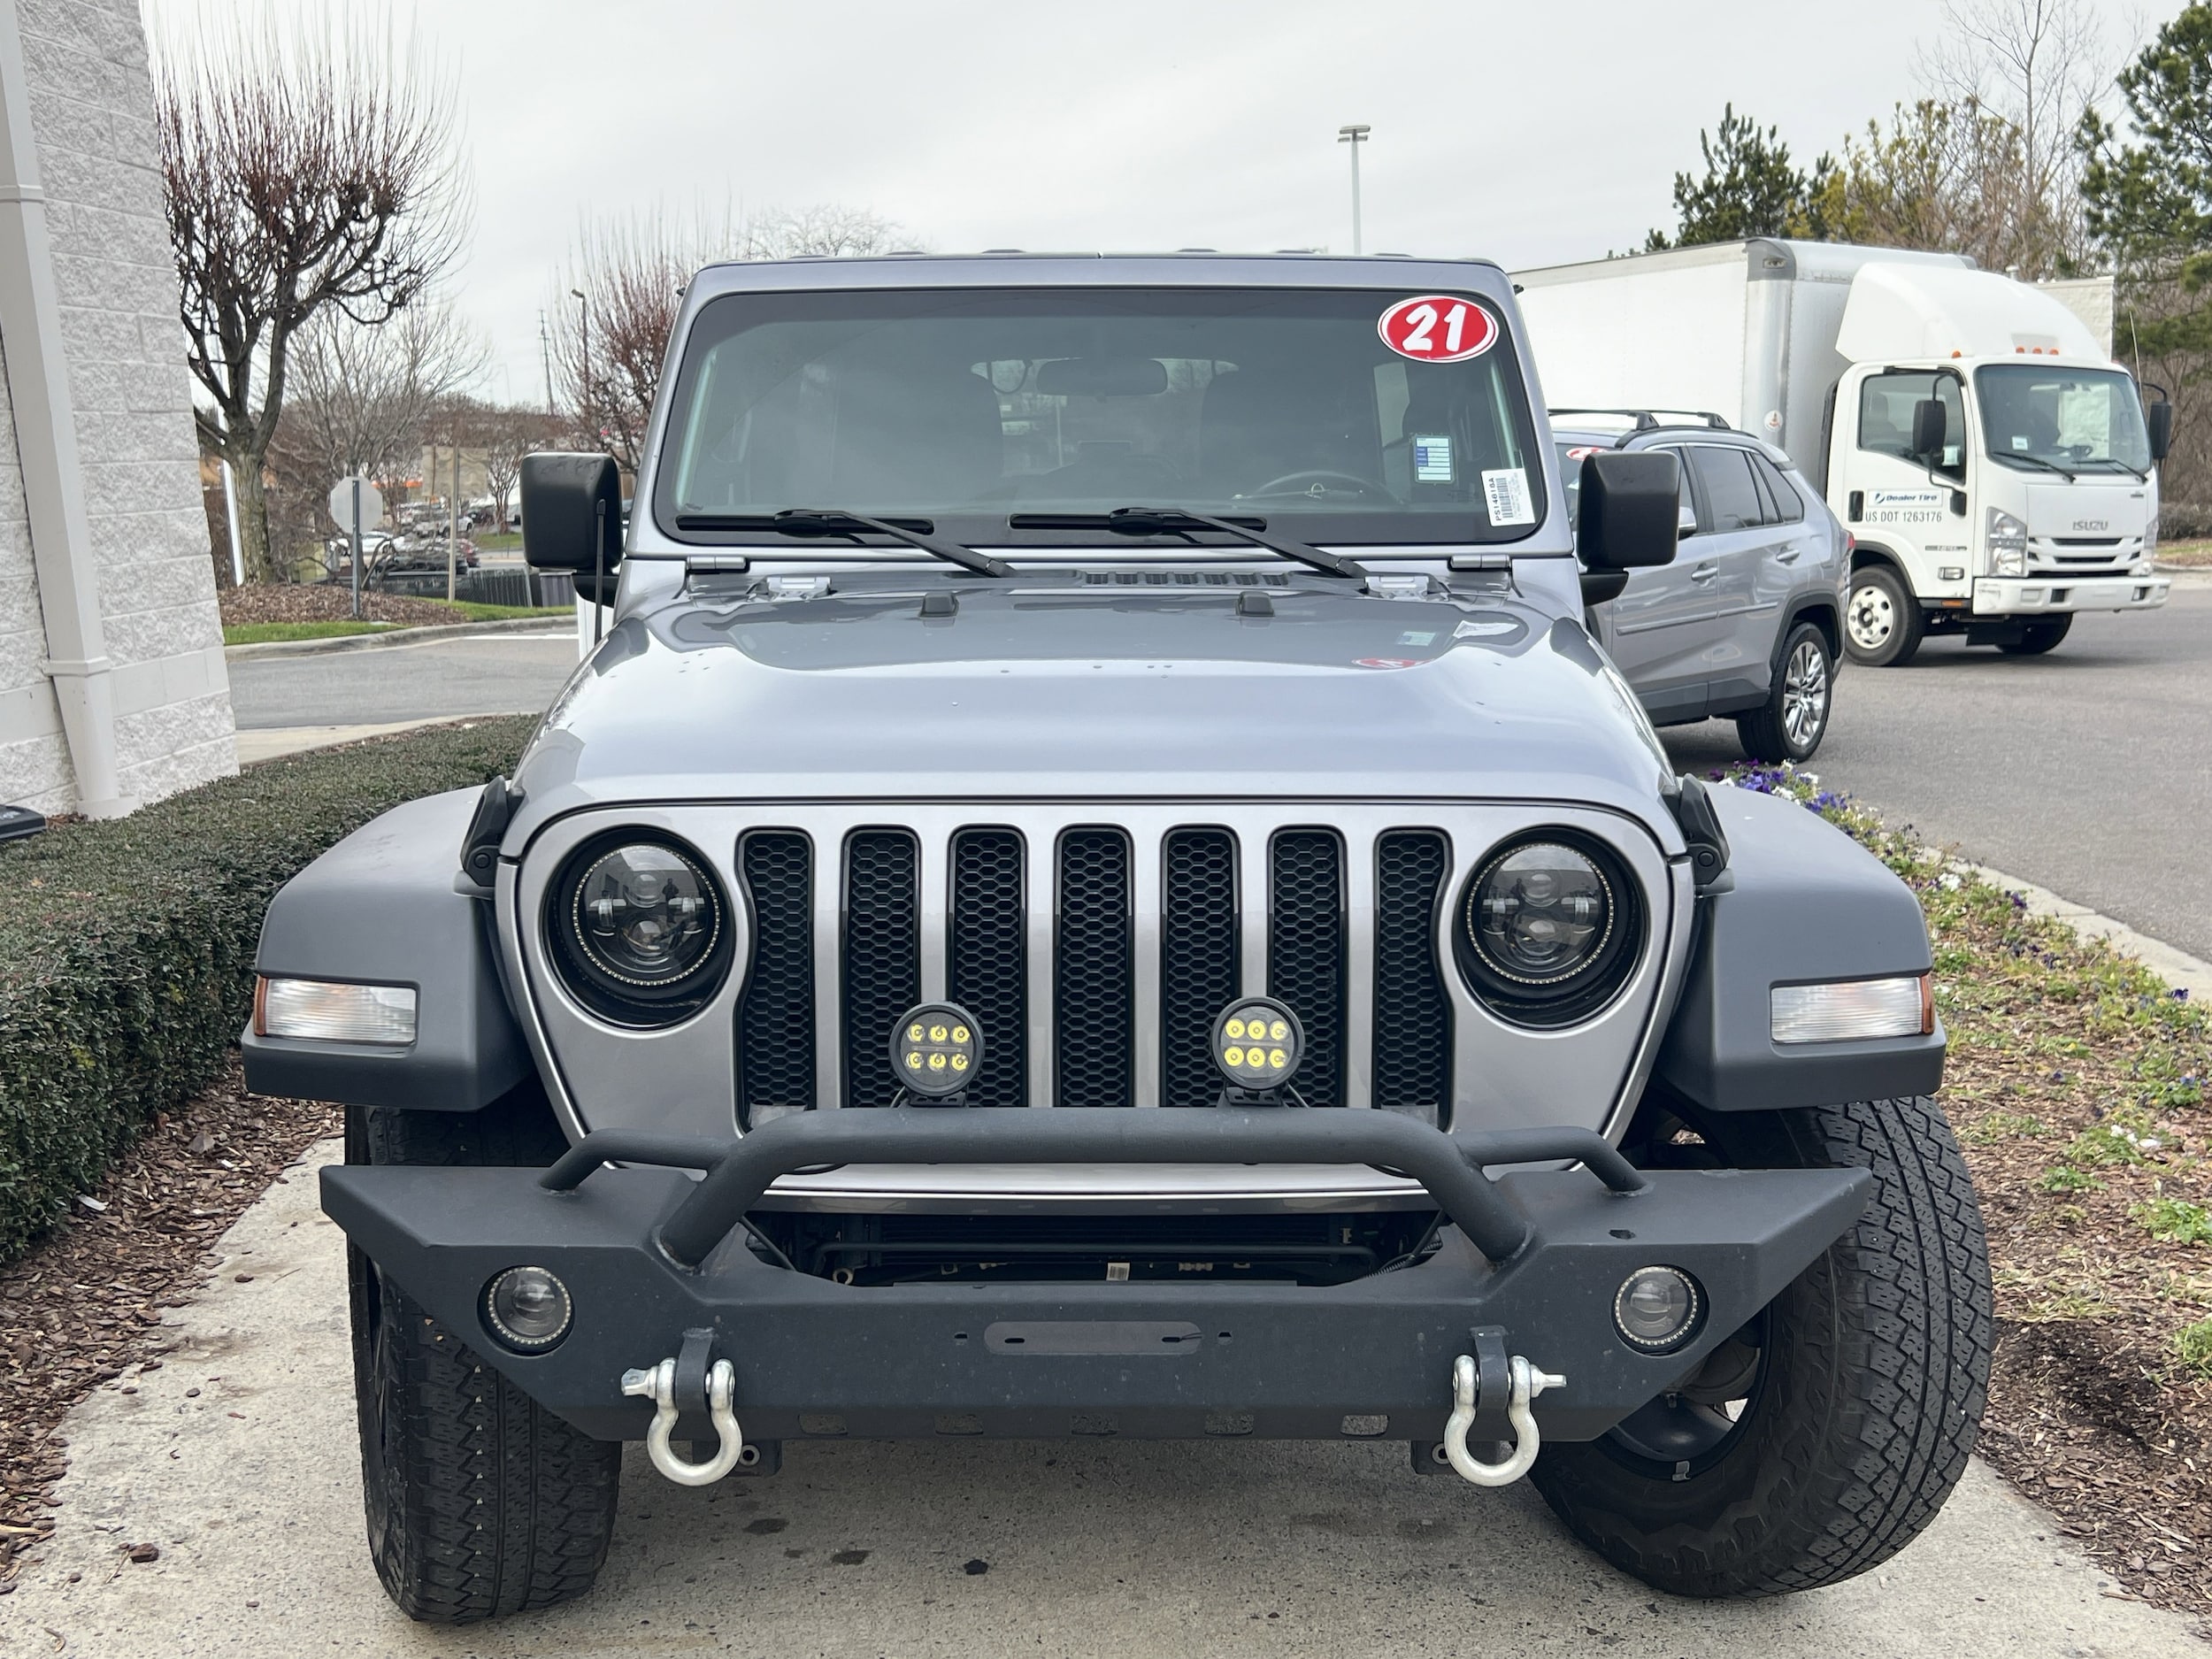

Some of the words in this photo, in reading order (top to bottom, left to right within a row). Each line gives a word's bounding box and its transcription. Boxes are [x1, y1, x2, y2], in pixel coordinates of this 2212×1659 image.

[1402, 303, 1466, 351] 21
[1865, 511, 1878, 523] US
[1880, 511, 1899, 522] DOT
[1903, 511, 1942, 523] 1263176
[2072, 519, 2108, 531] ISUZU
